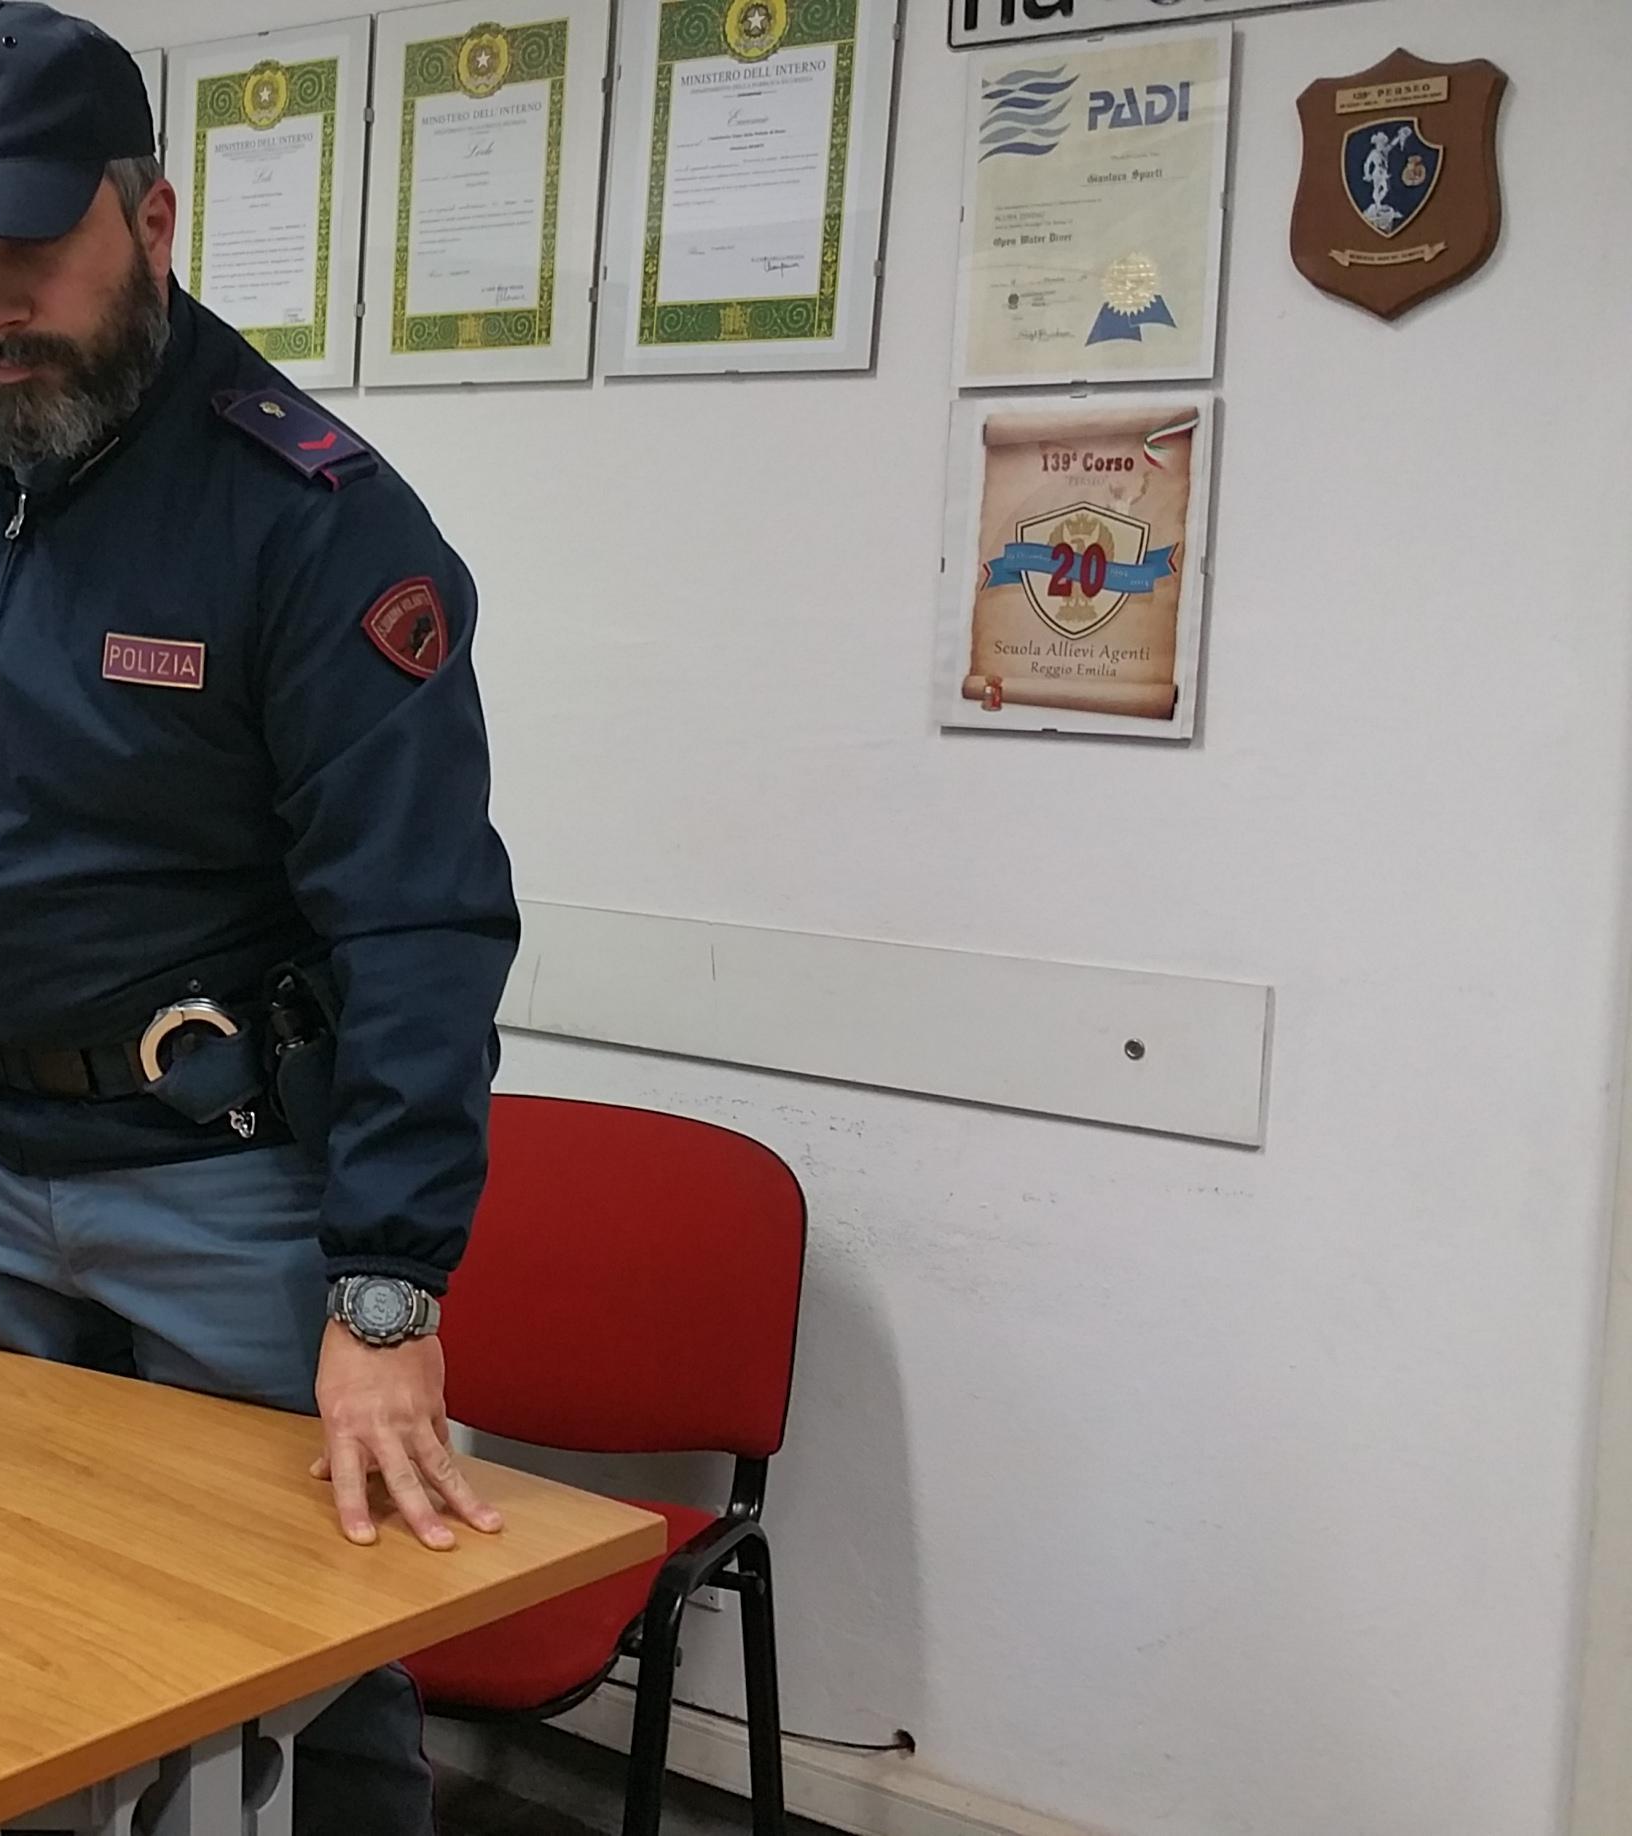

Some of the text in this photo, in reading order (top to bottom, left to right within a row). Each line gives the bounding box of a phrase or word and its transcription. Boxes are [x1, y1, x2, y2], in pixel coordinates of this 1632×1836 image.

[680, 70, 741, 87] MINISTERO
[1087, 81, 1191, 132] PADI
[421, 112, 470, 126] MINISTERO
[1082, 452, 1135, 472] Corso
[1047, 542, 1107, 598] 20
[109, 644, 196, 678] POLIZIA
[993, 640, 1151, 664] Scuola Allievi Agenti
[1030, 661, 1117, 679] Reggio Emilia
